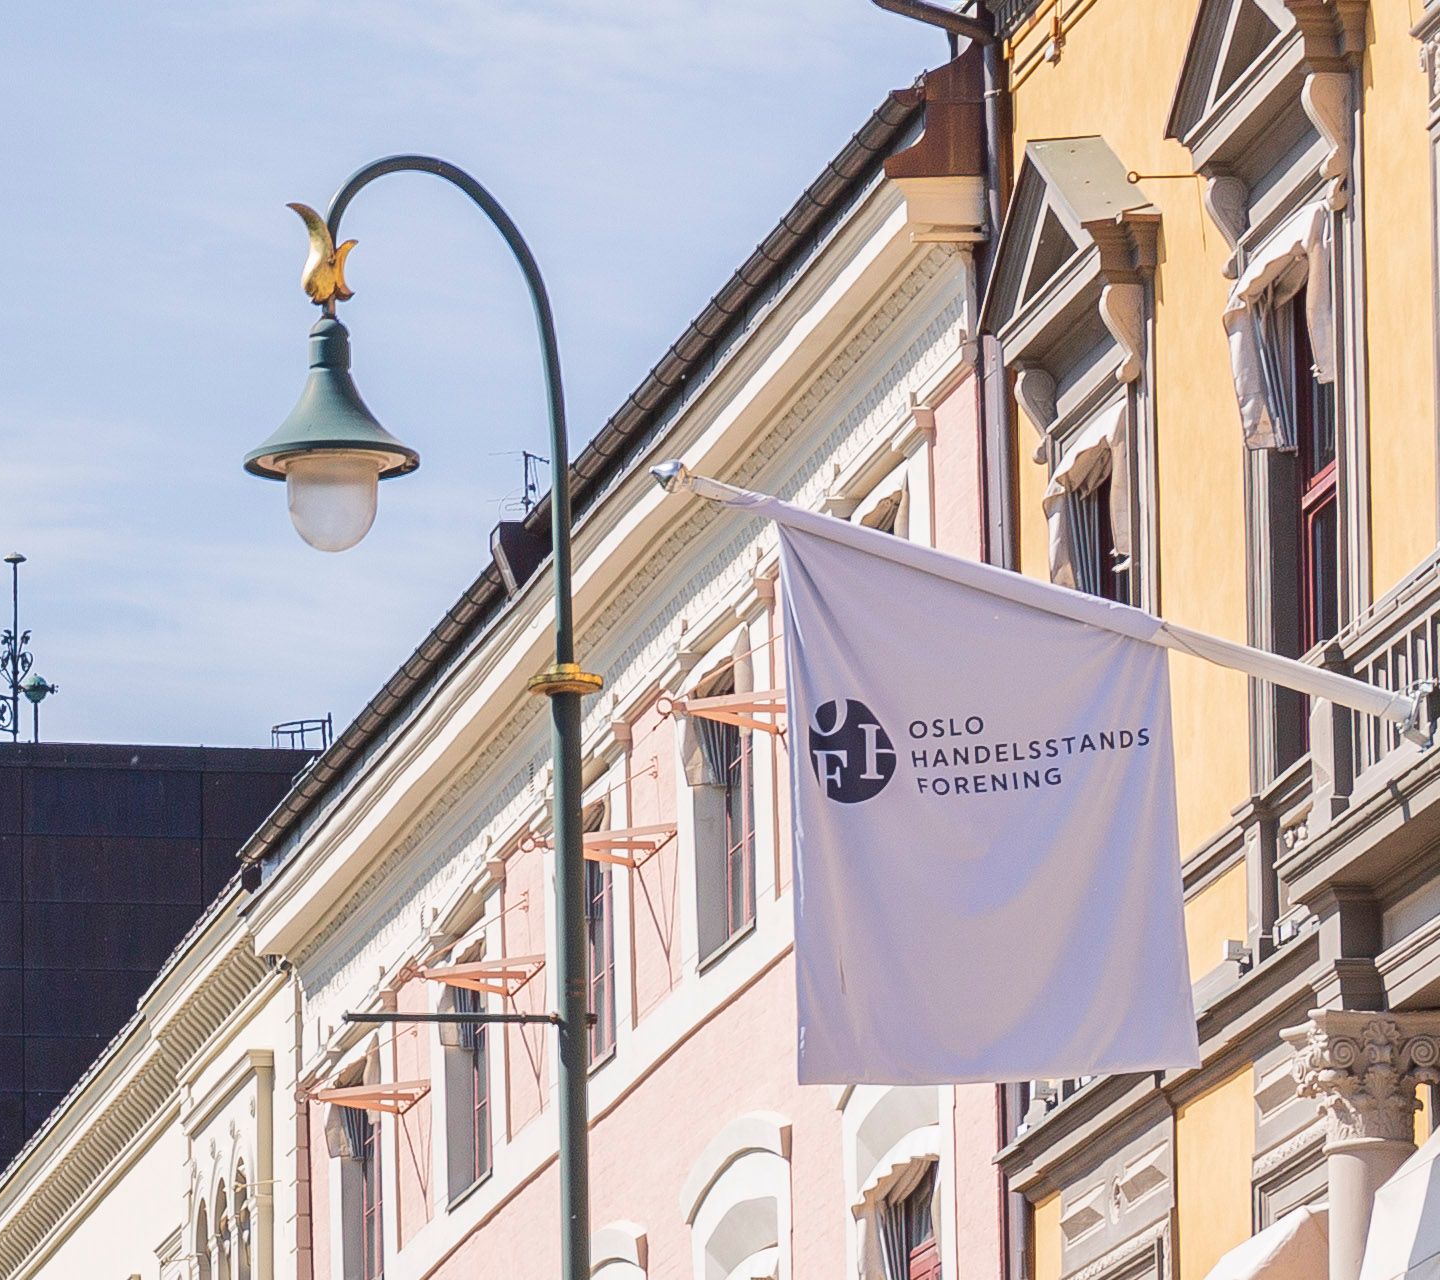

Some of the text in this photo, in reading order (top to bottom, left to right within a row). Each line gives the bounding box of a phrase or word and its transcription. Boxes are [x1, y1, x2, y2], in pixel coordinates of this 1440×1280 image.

[909, 716, 984, 739] OSLO
[911, 728, 1150, 768] HANDELSSTANDS
[917, 767, 1062, 796] FORENING
